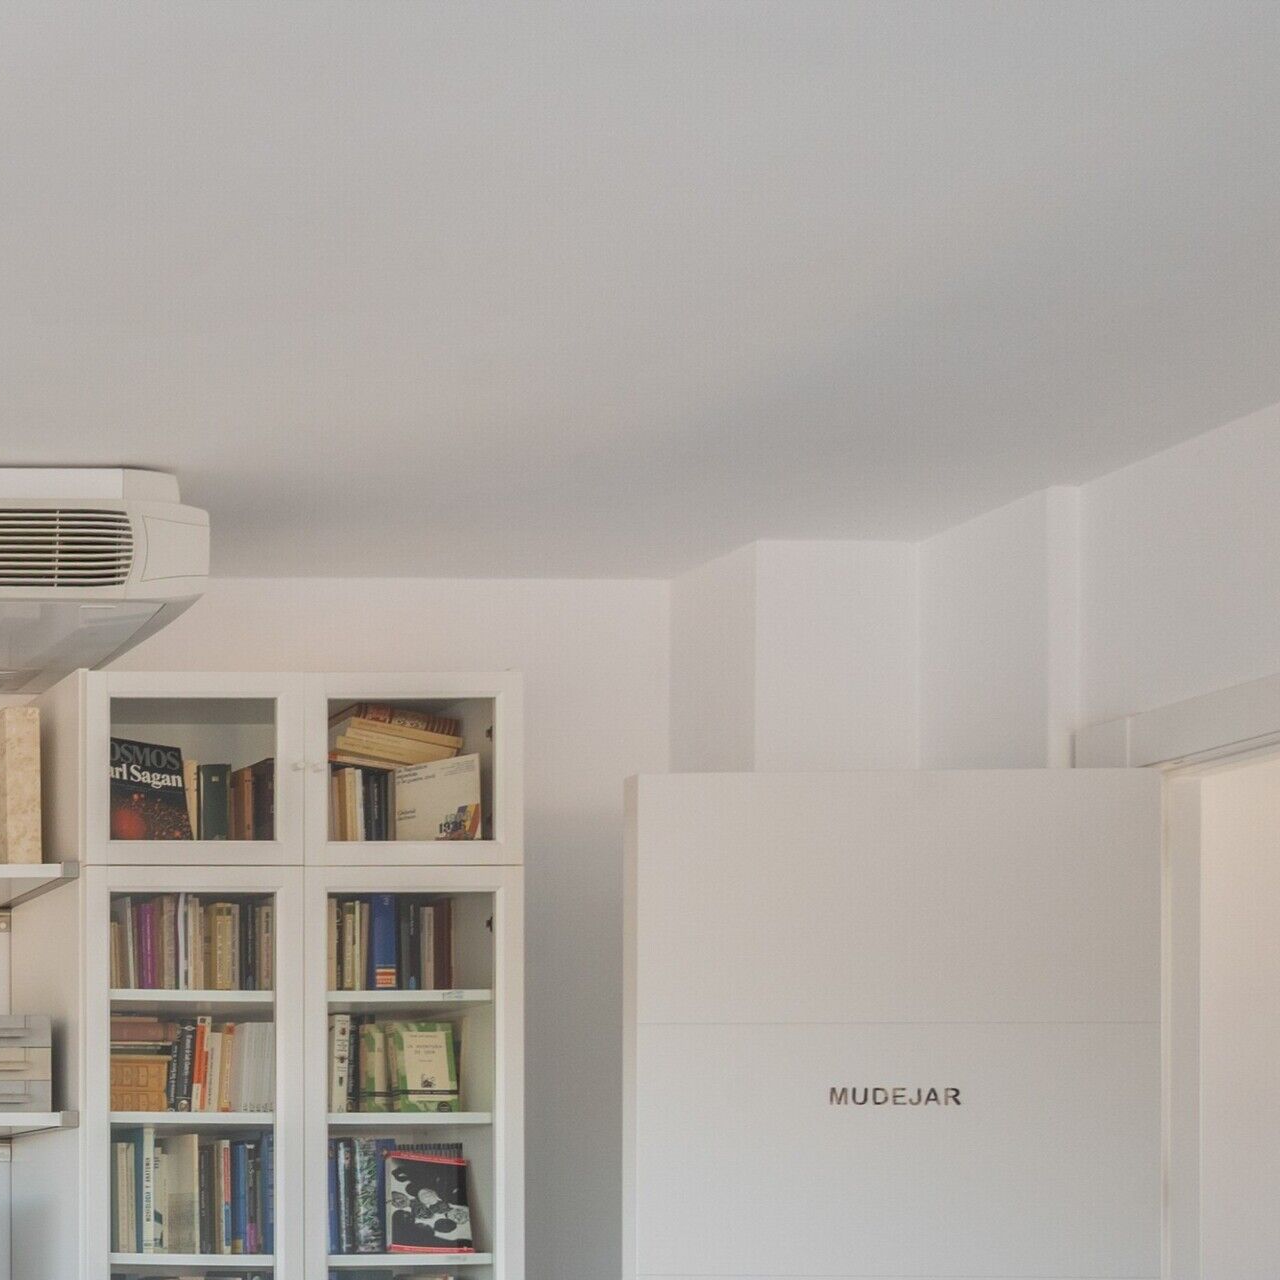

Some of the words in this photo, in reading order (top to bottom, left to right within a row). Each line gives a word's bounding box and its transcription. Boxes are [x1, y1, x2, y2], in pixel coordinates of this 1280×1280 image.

[110, 742, 180, 770] OSMOS
[110, 763, 127, 780] arl
[129, 764, 183, 789] Sagan
[829, 1087, 962, 1106] MUDEJAR
